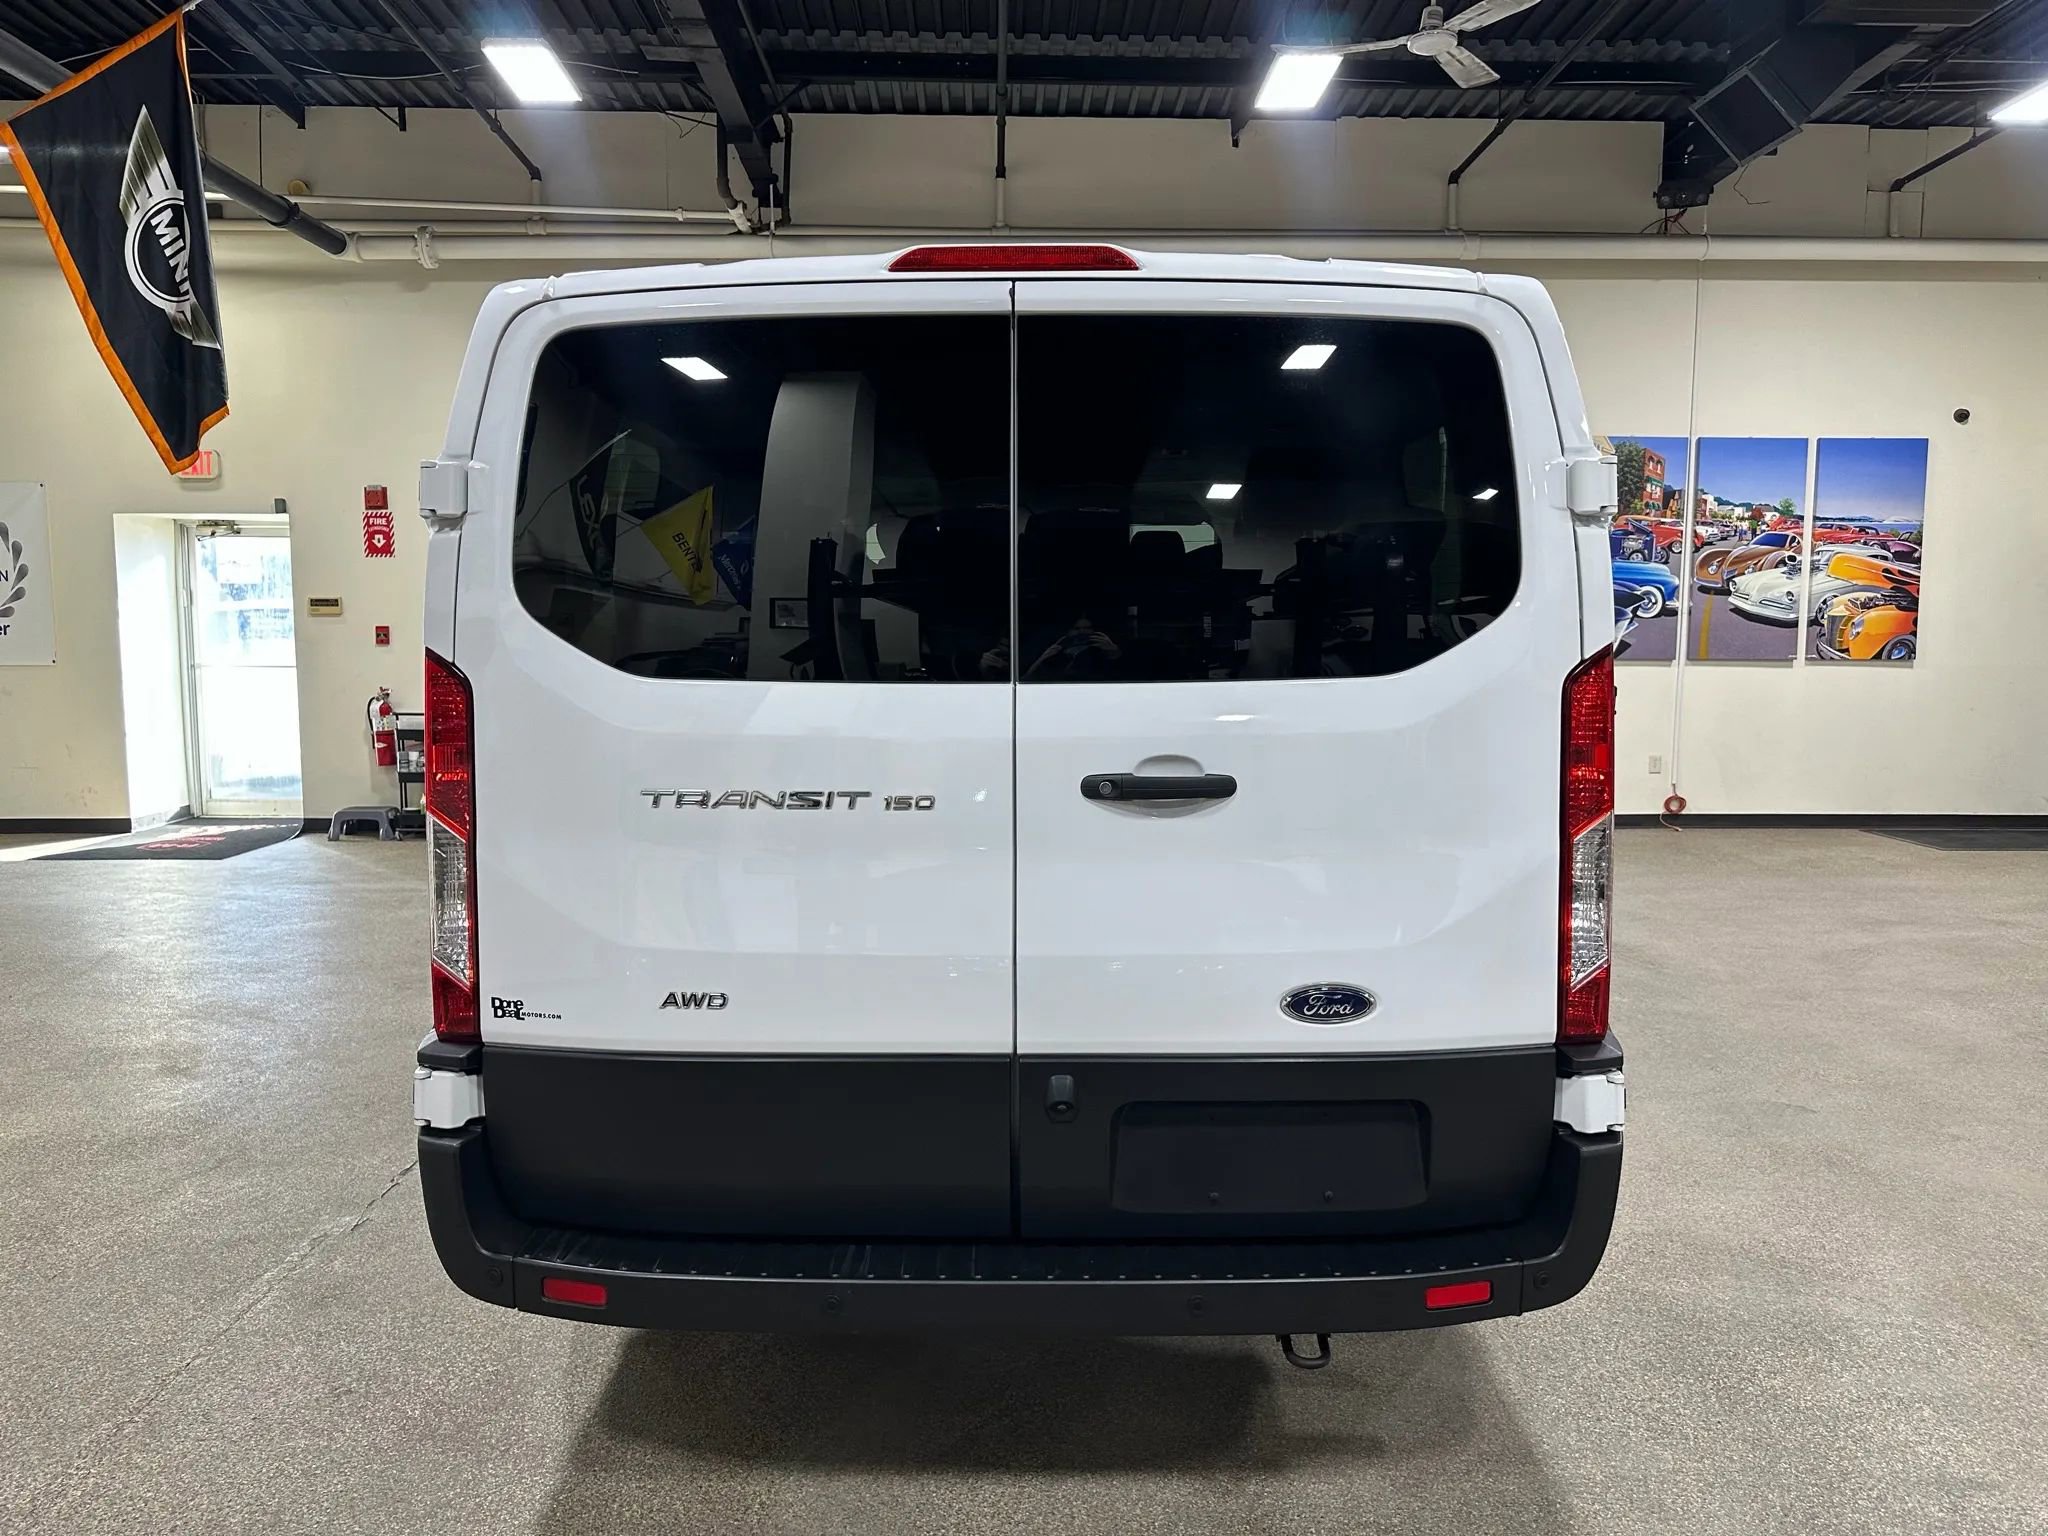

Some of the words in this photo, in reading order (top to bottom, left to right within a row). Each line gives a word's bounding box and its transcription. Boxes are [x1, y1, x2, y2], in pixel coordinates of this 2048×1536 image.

[181, 451, 213, 476] XIT
[369, 517, 388, 526] FIRE
[640, 788, 873, 811] TRANSIT
[883, 794, 937, 812] 150
[491, 996, 524, 1010] Done
[659, 991, 729, 1010] AWD
[1303, 994, 1354, 1016] Ford
[521, 1011, 562, 1020] MOTORS.COM
